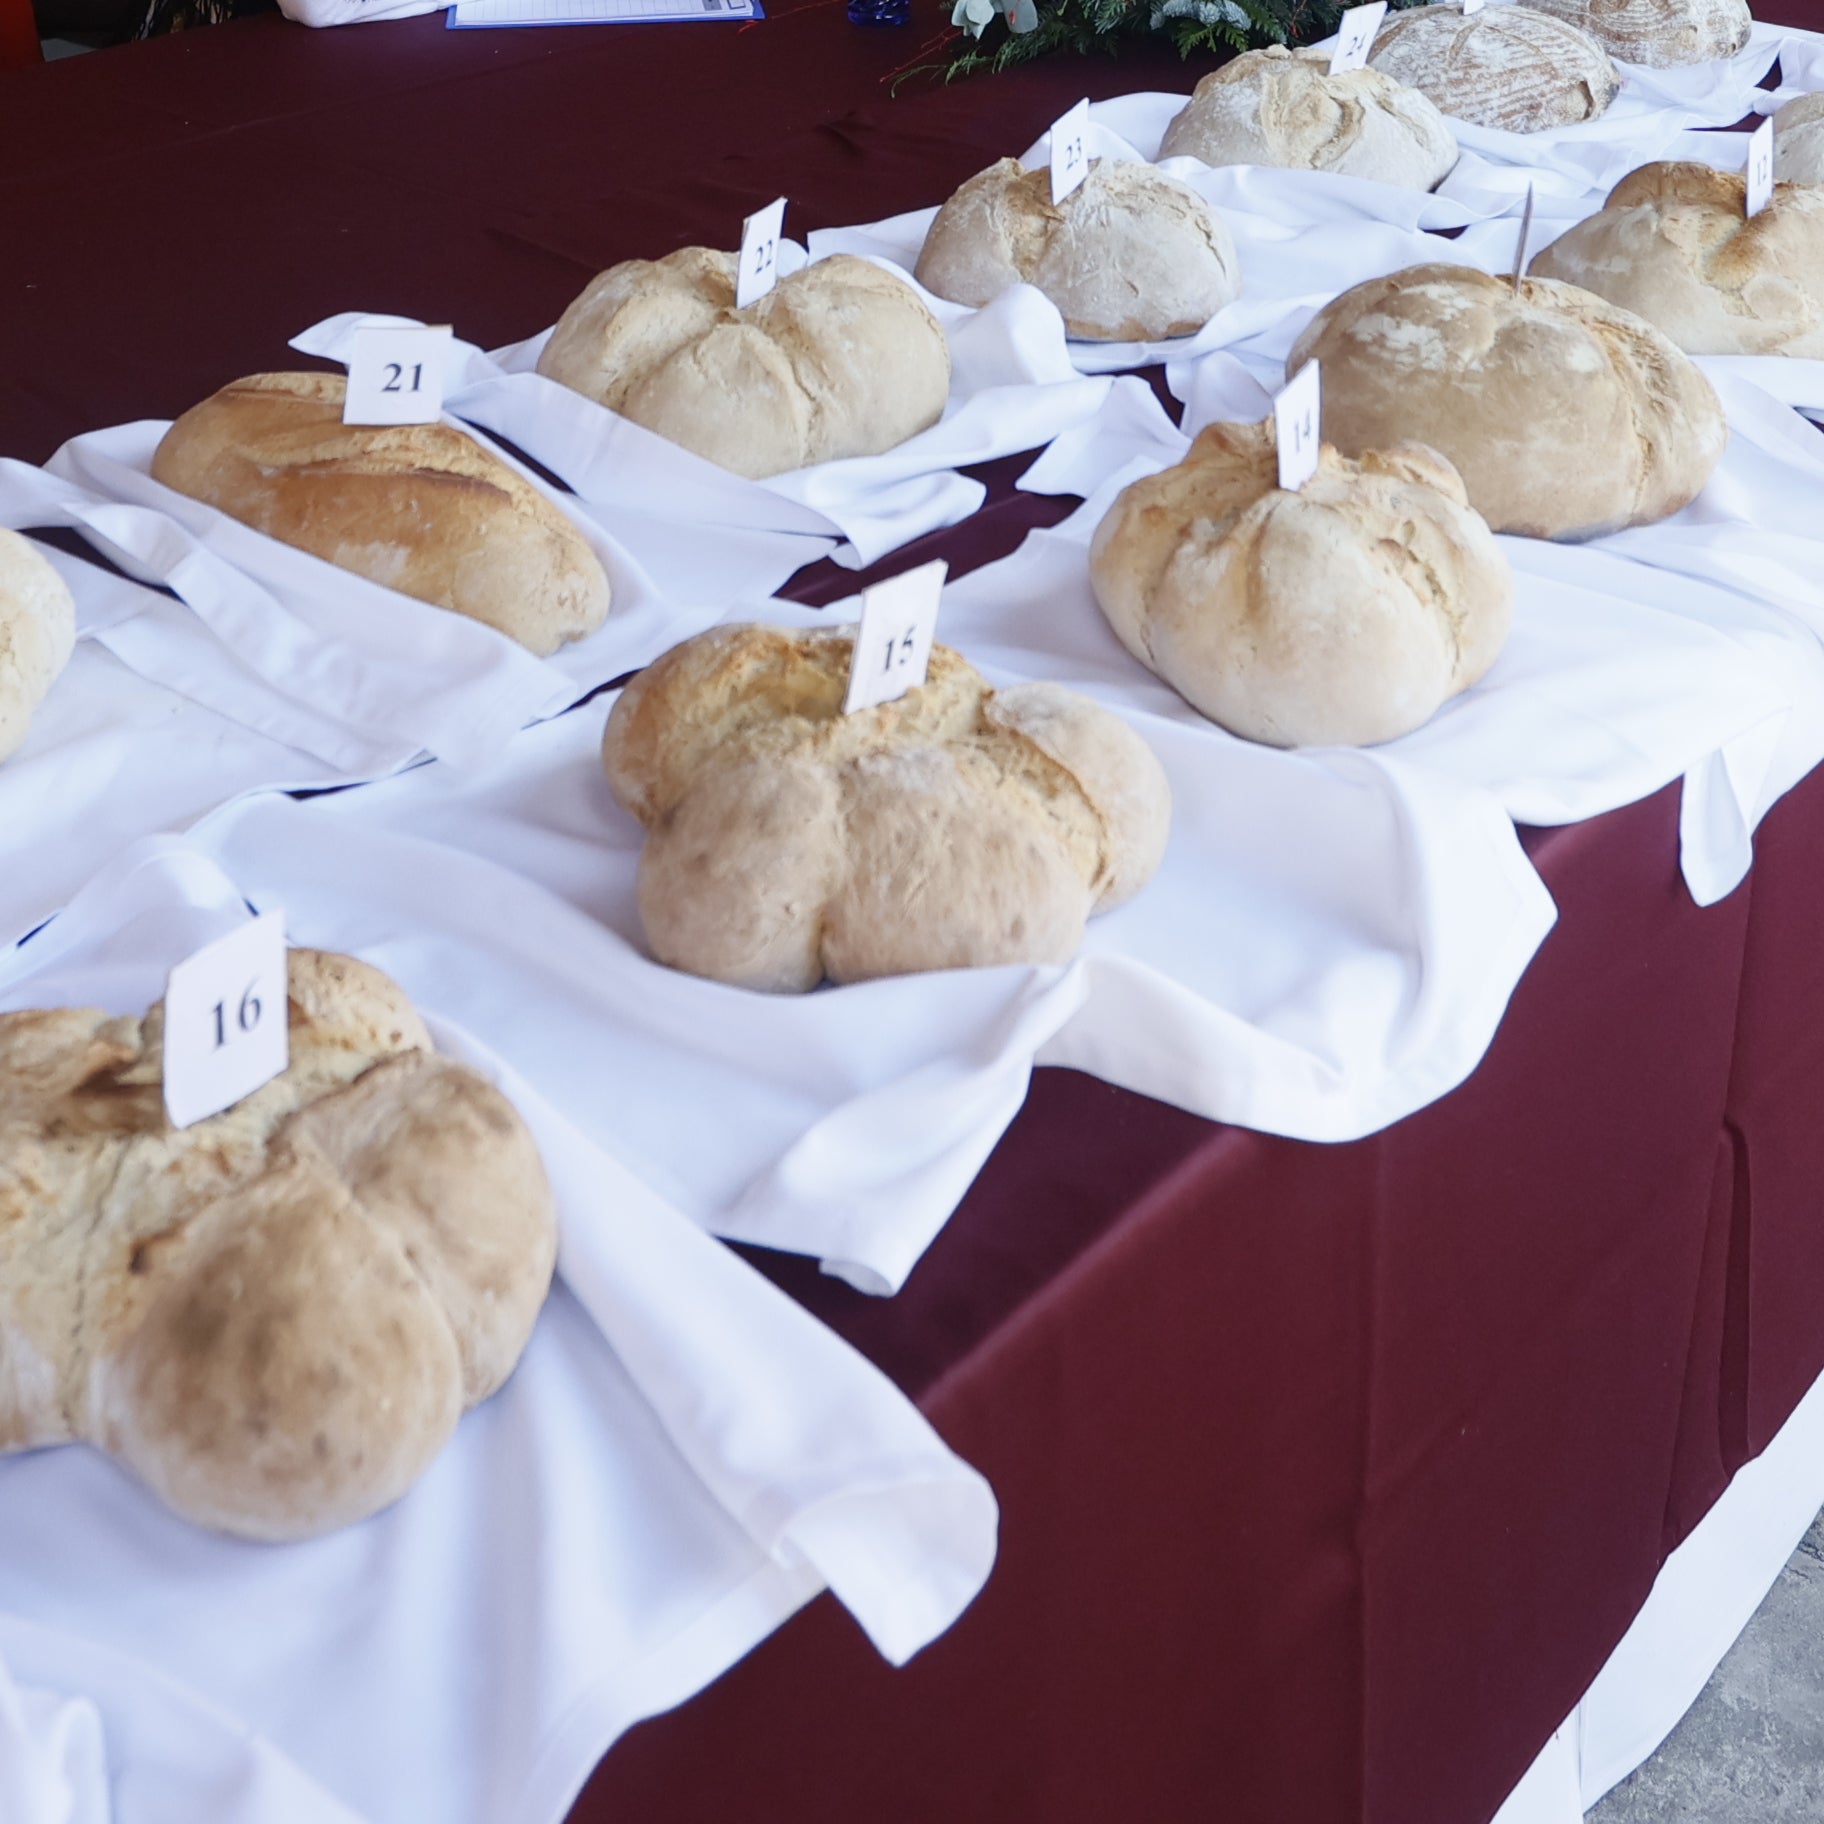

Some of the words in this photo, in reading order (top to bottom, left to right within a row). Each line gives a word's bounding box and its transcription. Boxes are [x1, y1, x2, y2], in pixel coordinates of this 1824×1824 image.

[1346, 32, 1367, 57] 24
[1757, 154, 1767, 187] 12
[755, 238, 773, 275] 22
[381, 363, 423, 393] 21
[1294, 407, 1311, 454] 14
[883, 623, 917, 673] 15
[211, 973, 262, 1055] 16
